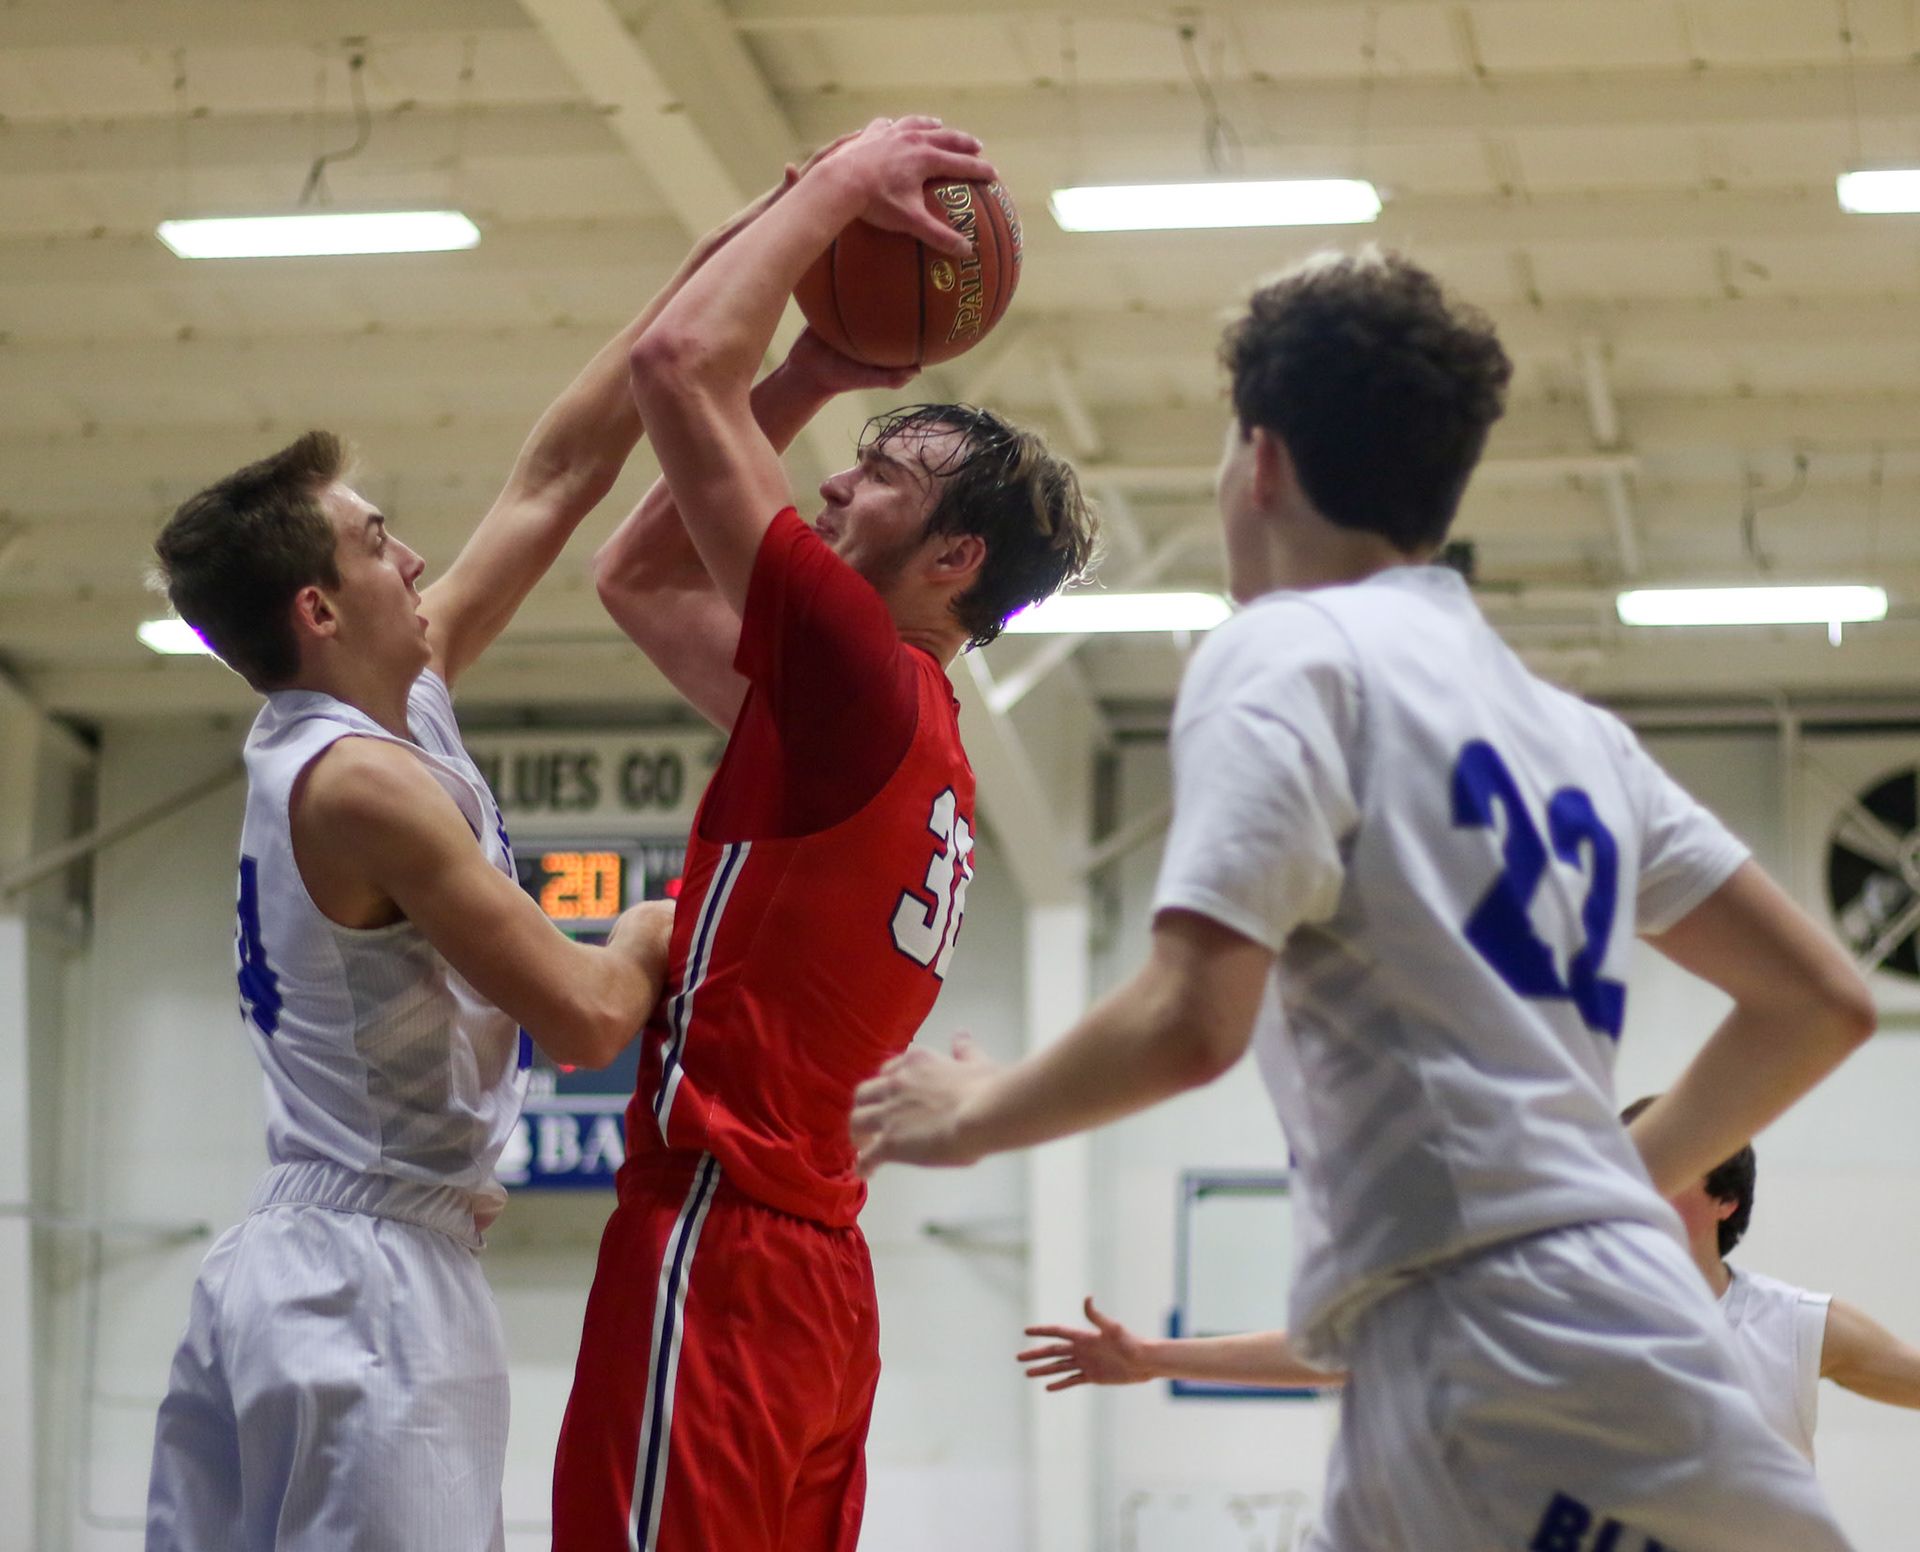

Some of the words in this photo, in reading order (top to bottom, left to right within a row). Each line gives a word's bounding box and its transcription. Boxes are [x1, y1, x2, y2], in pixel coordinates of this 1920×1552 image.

[619, 748, 685, 812] GO
[540, 852, 621, 920] 20
[1449, 736, 1626, 1042] 22
